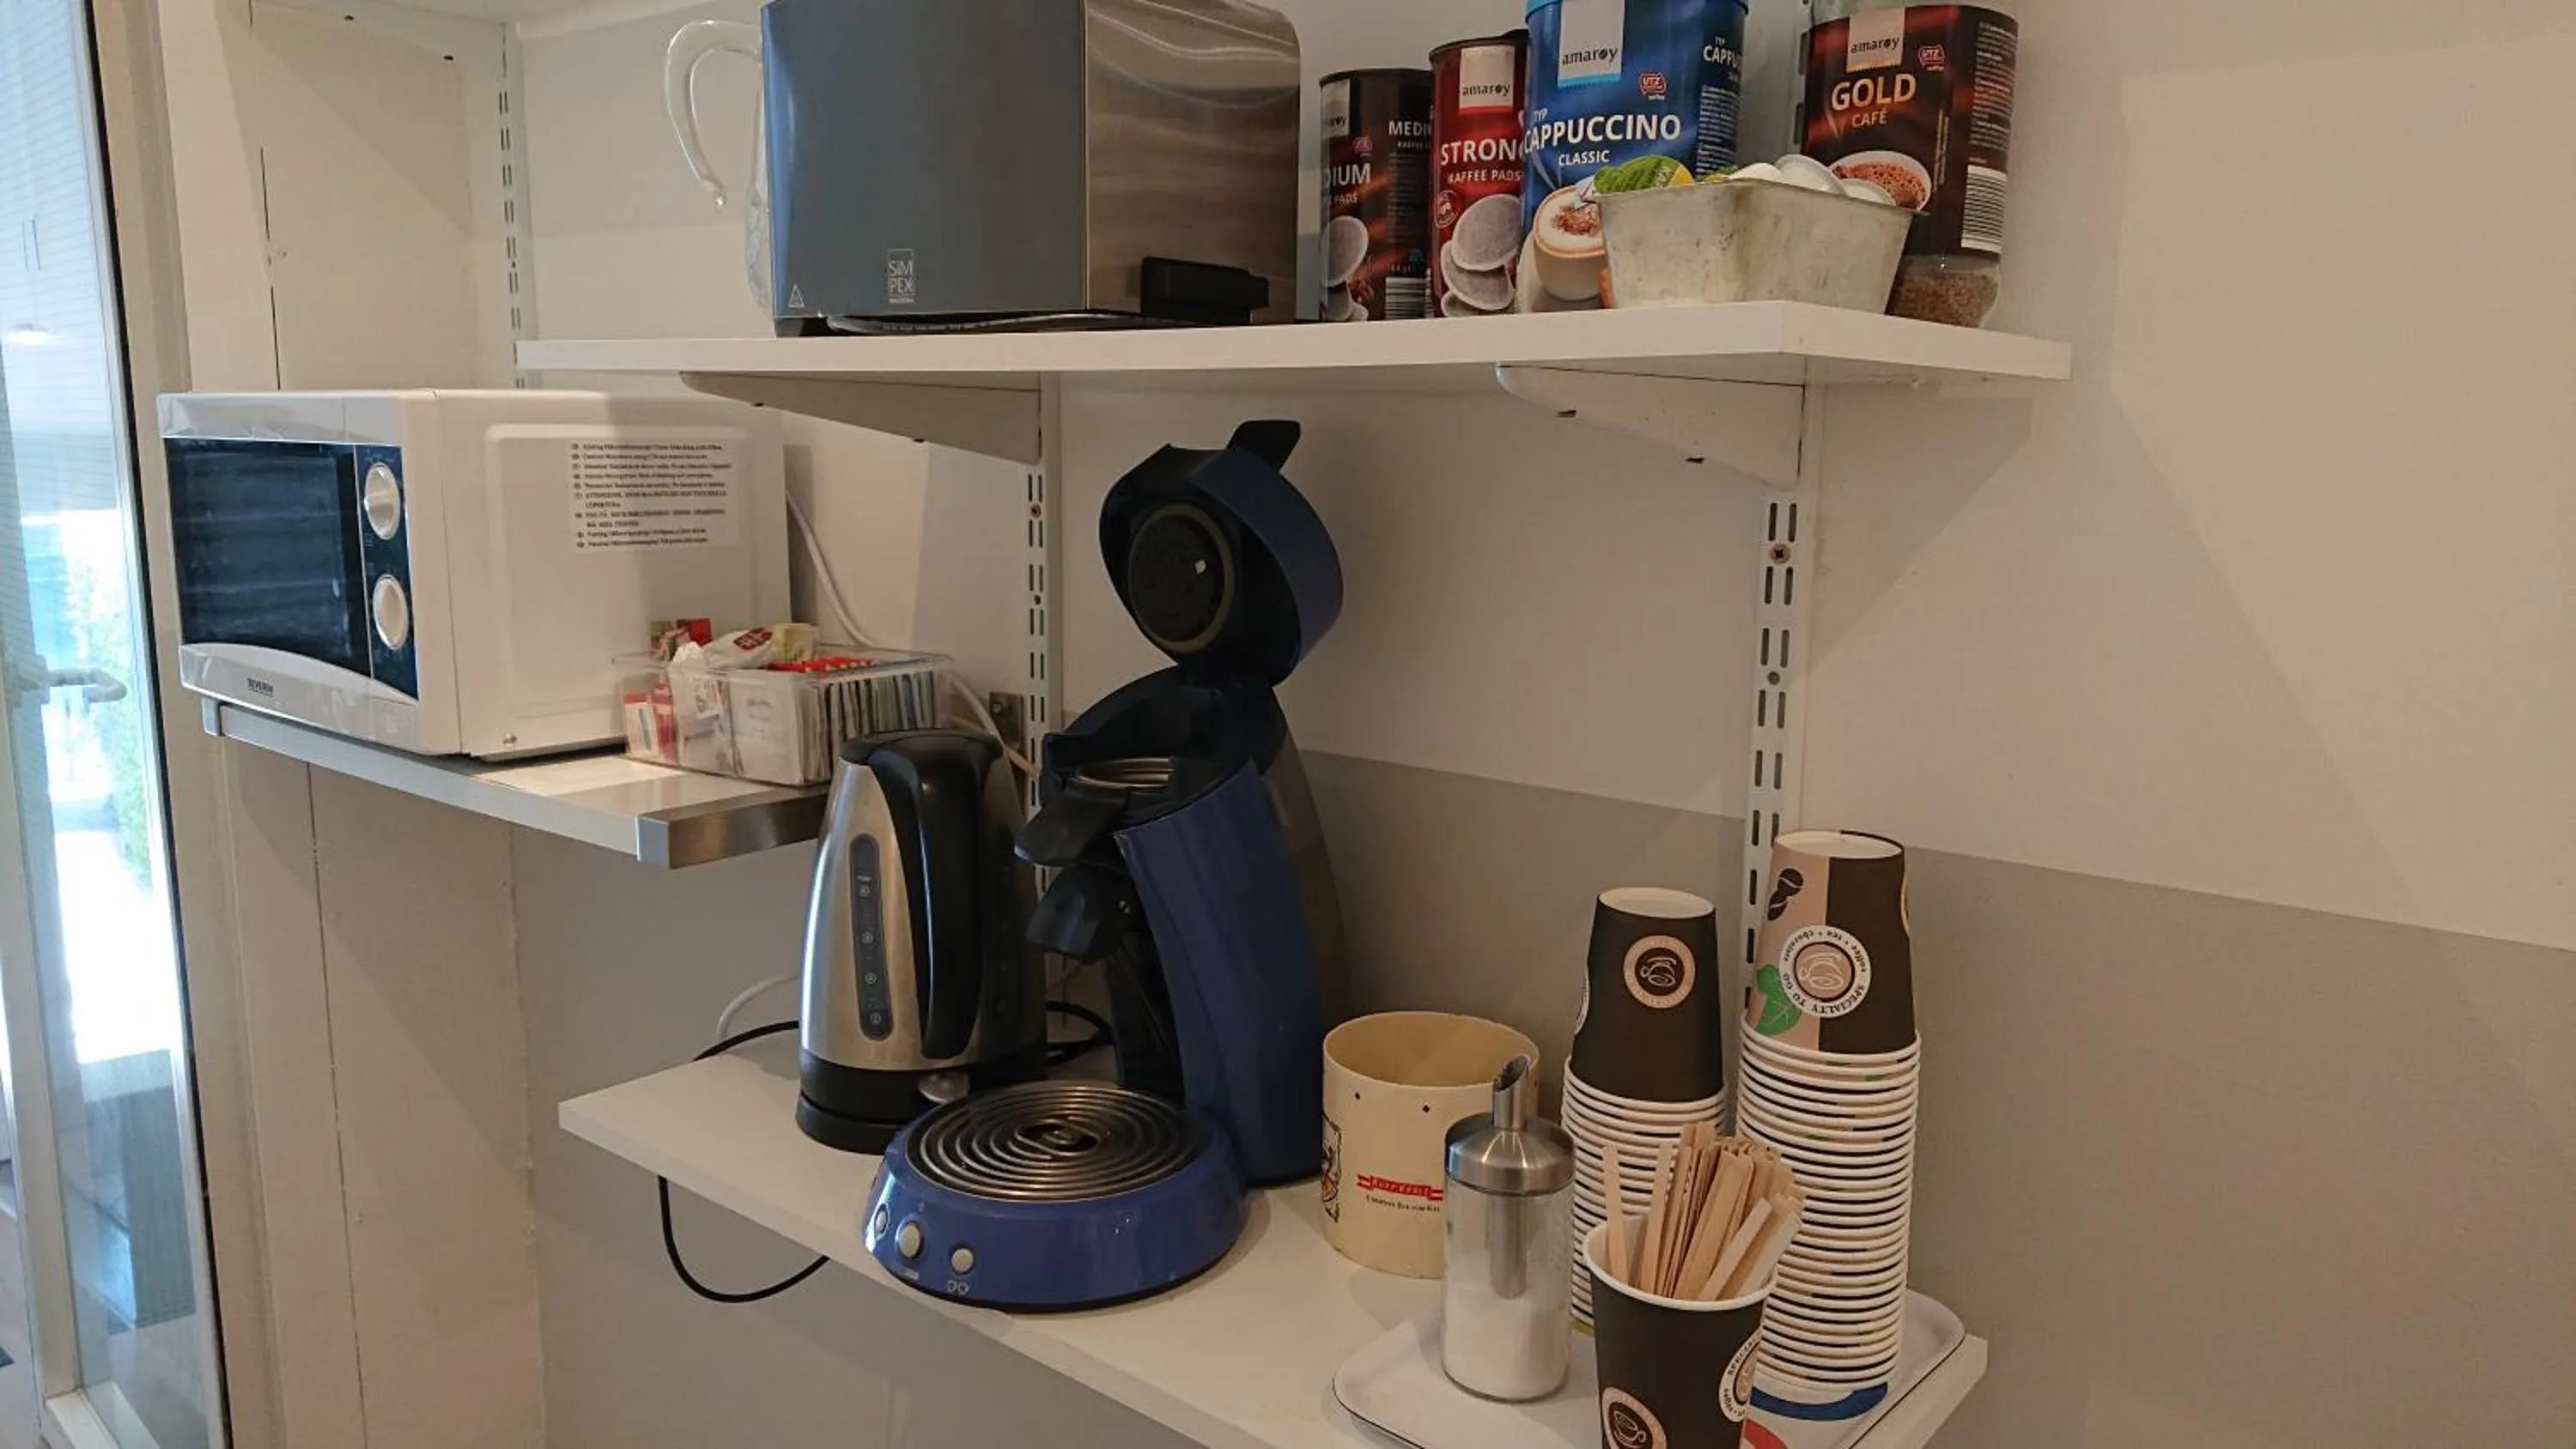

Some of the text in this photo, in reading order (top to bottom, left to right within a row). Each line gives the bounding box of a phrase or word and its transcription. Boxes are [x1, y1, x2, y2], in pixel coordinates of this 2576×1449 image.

[1850, 37, 1900, 53] amaroy
[1562, 47, 1619, 66] amaroy
[1462, 82, 1510, 97] amaroy
[1642, 76, 1662, 87] UTZ
[1832, 73, 1917, 111] GOLD
[1852, 105, 1887, 128] CAFÉ
[1524, 114, 1680, 154] CAPPUCCINO
[1558, 150, 1610, 167] CLASSIC
[1323, 162, 1371, 187] DIUM
[1448, 169, 1522, 185] KAFFEE PADS
[1826, 931, 1842, 941] tea
[1782, 973, 1864, 1014] SPECIALTY TO GO
